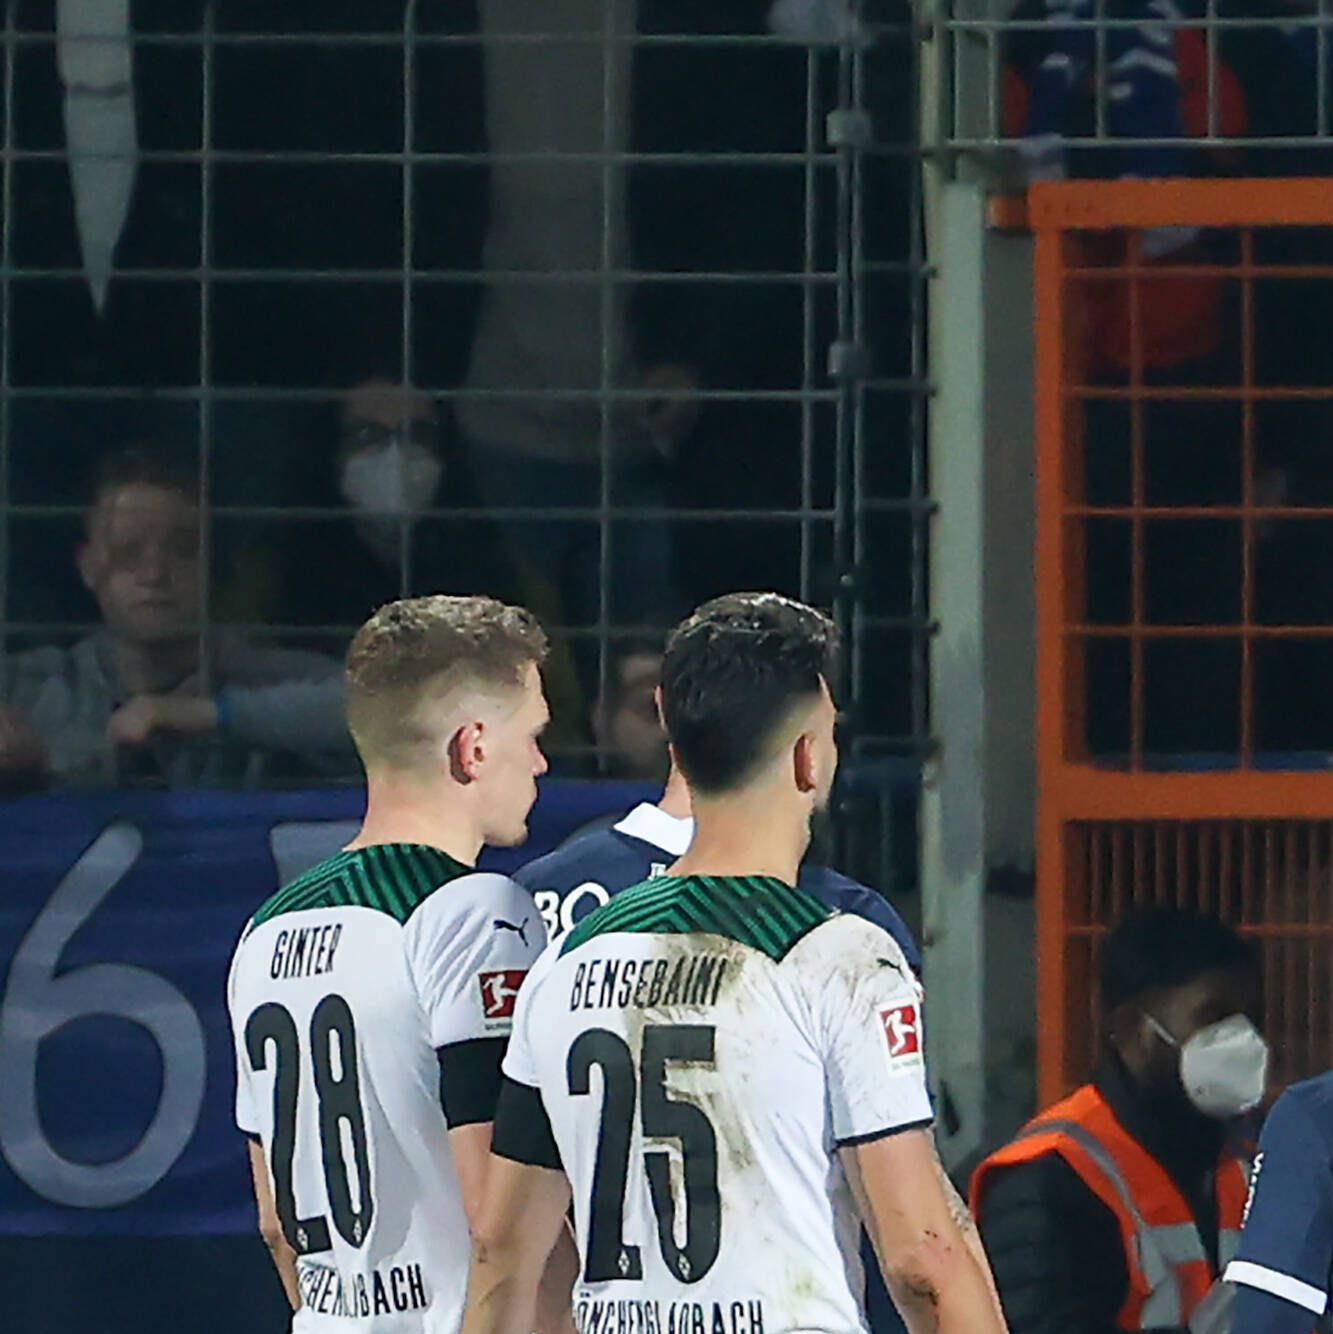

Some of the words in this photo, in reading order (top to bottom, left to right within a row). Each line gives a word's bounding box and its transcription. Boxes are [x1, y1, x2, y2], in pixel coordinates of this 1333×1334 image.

[271, 923, 343, 980] GINTER
[570, 955, 728, 1012] BENSEBAINI
[245, 993, 375, 1256] 28
[567, 1024, 722, 1284] 25
